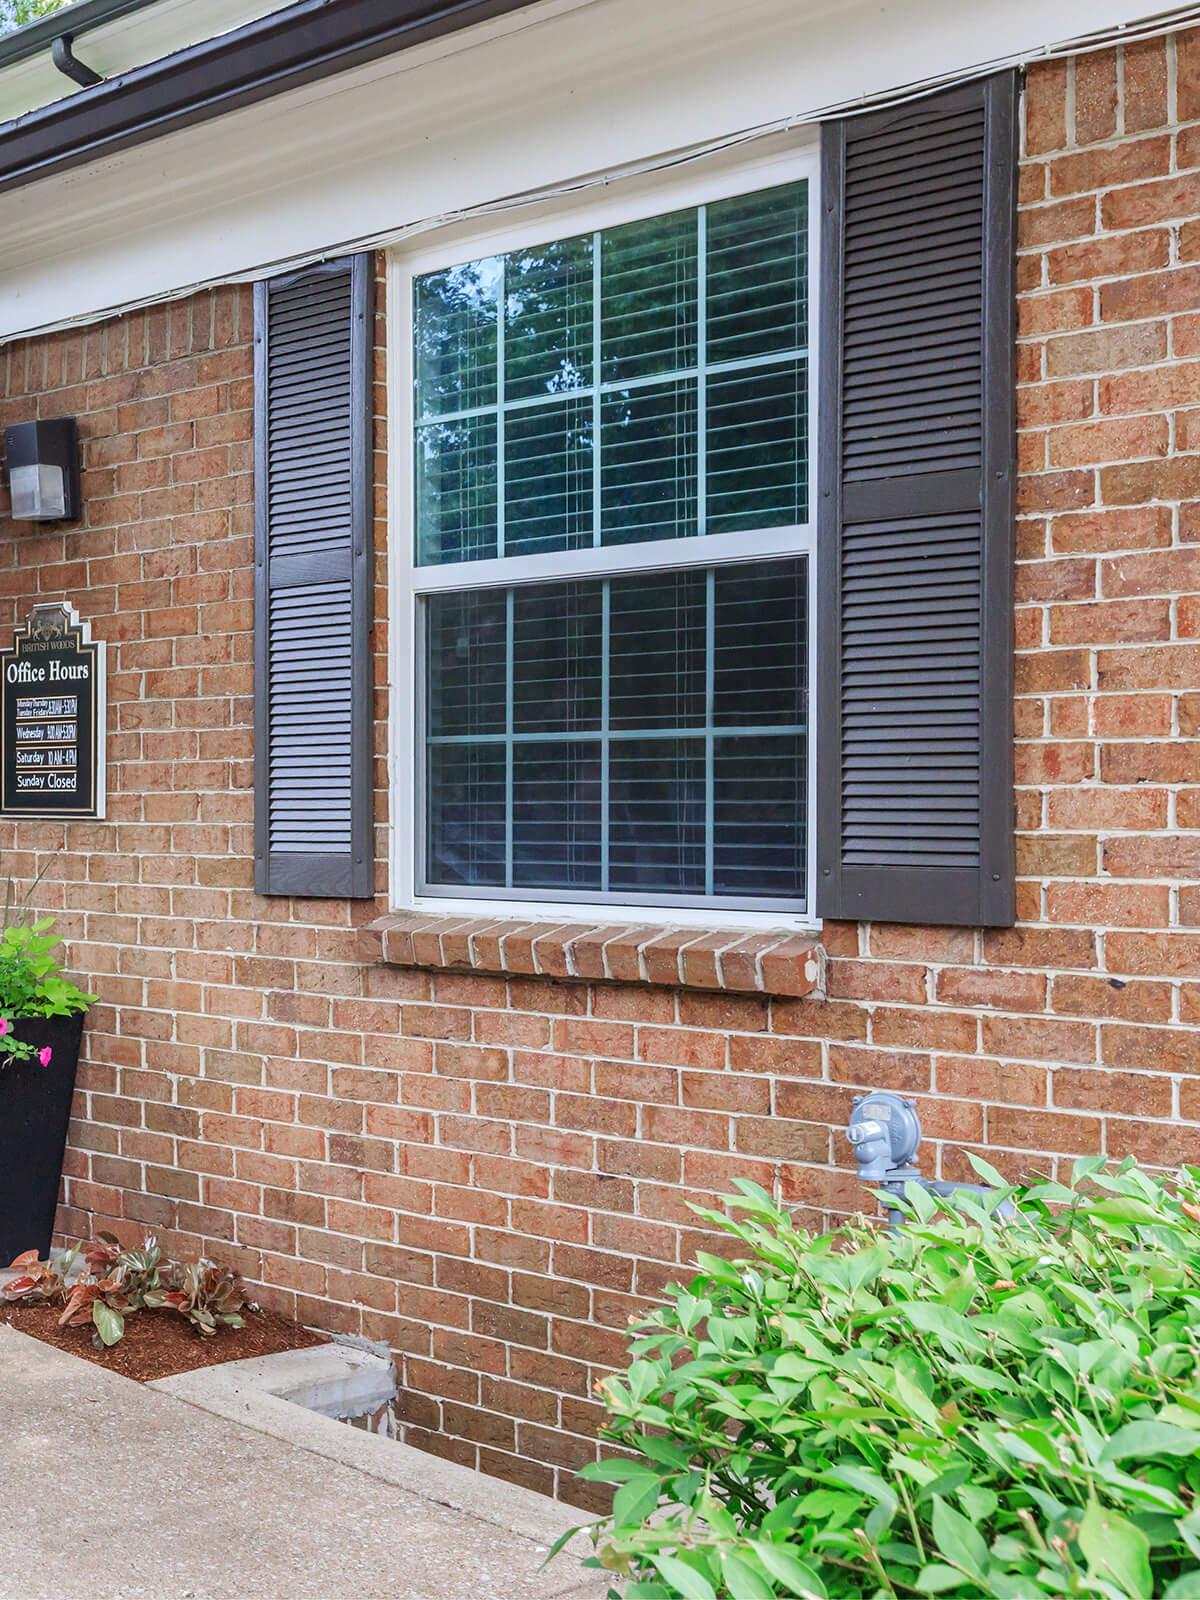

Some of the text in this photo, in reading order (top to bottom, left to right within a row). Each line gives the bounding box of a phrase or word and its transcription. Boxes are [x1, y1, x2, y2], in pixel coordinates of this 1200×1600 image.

[22, 640, 75, 652] BRITISH WOODS
[7, 660, 89, 684] Office Hours
[17, 726, 44, 741] Wednesday
[17, 751, 44, 766] Saturday
[17, 773, 77, 789] Sunday Closed
